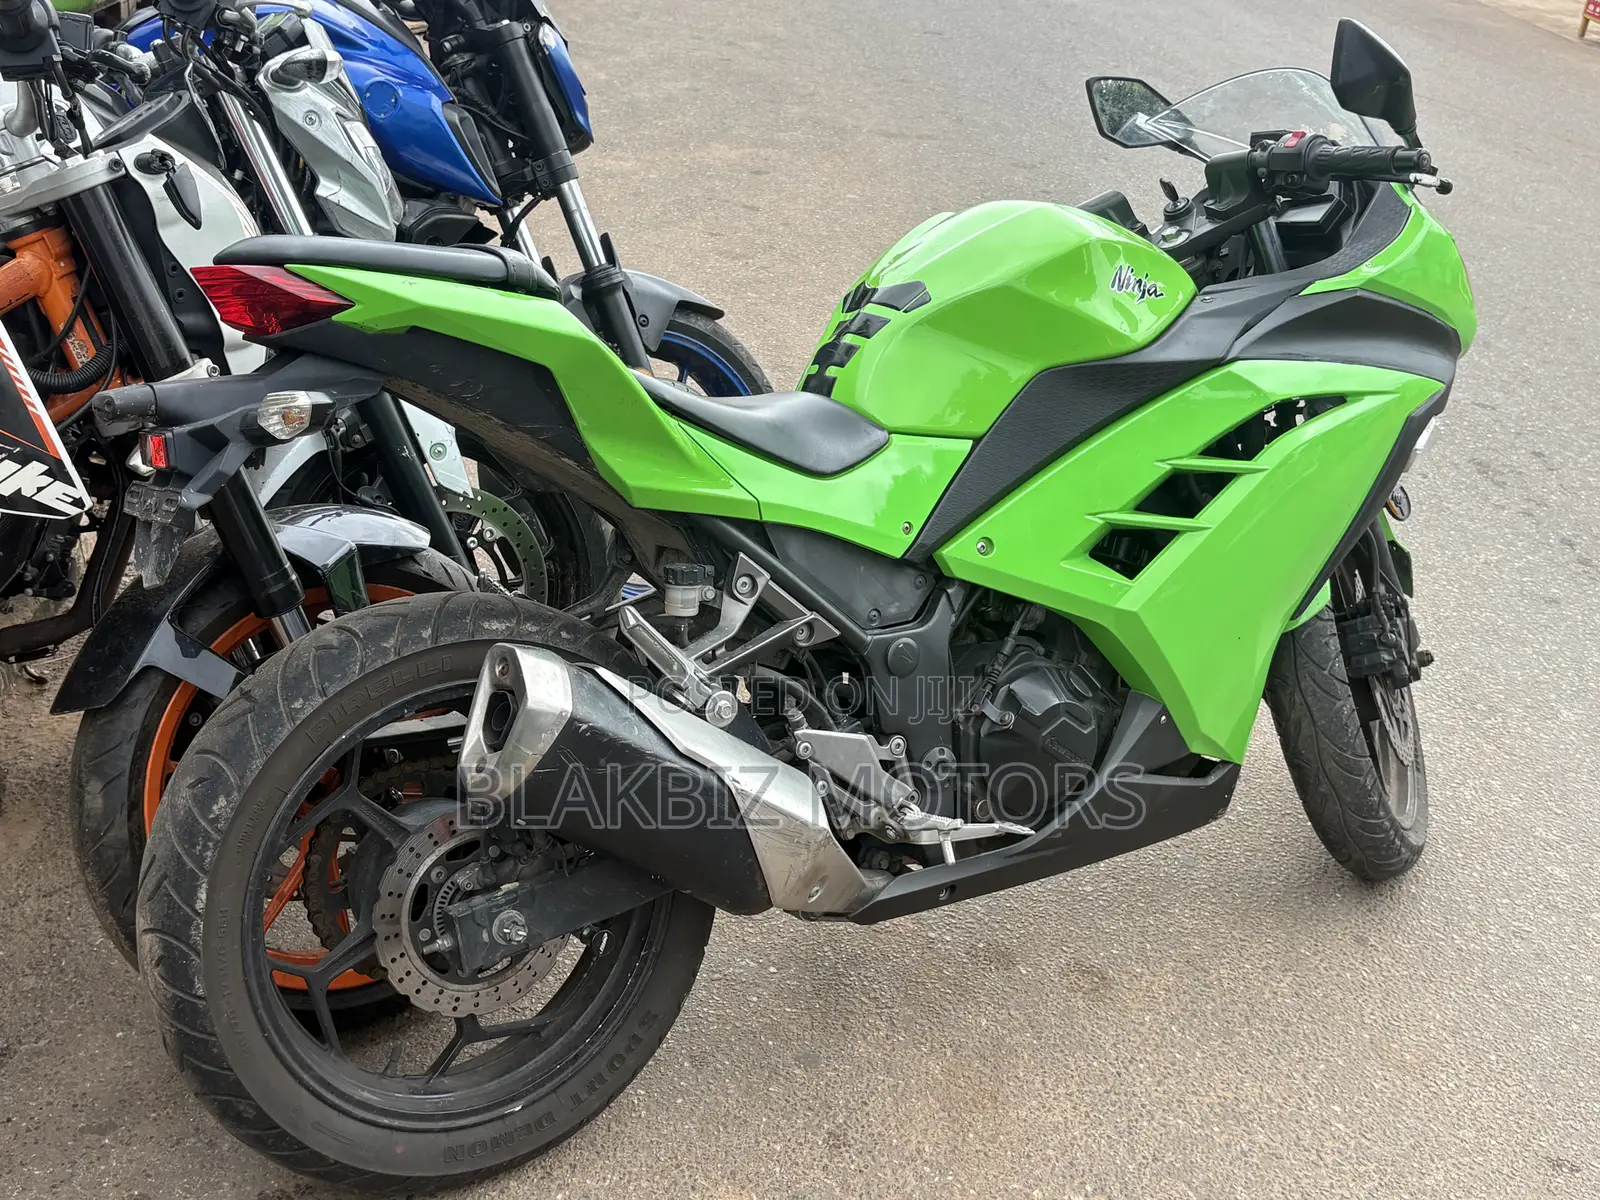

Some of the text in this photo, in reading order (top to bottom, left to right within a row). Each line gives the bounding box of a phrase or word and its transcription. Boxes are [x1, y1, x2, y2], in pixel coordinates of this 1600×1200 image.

[1110, 264, 1165, 303] Ninja
[306, 655, 451, 743] PIRELLI
[444, 1010, 660, 1163] SPORT DEMON
